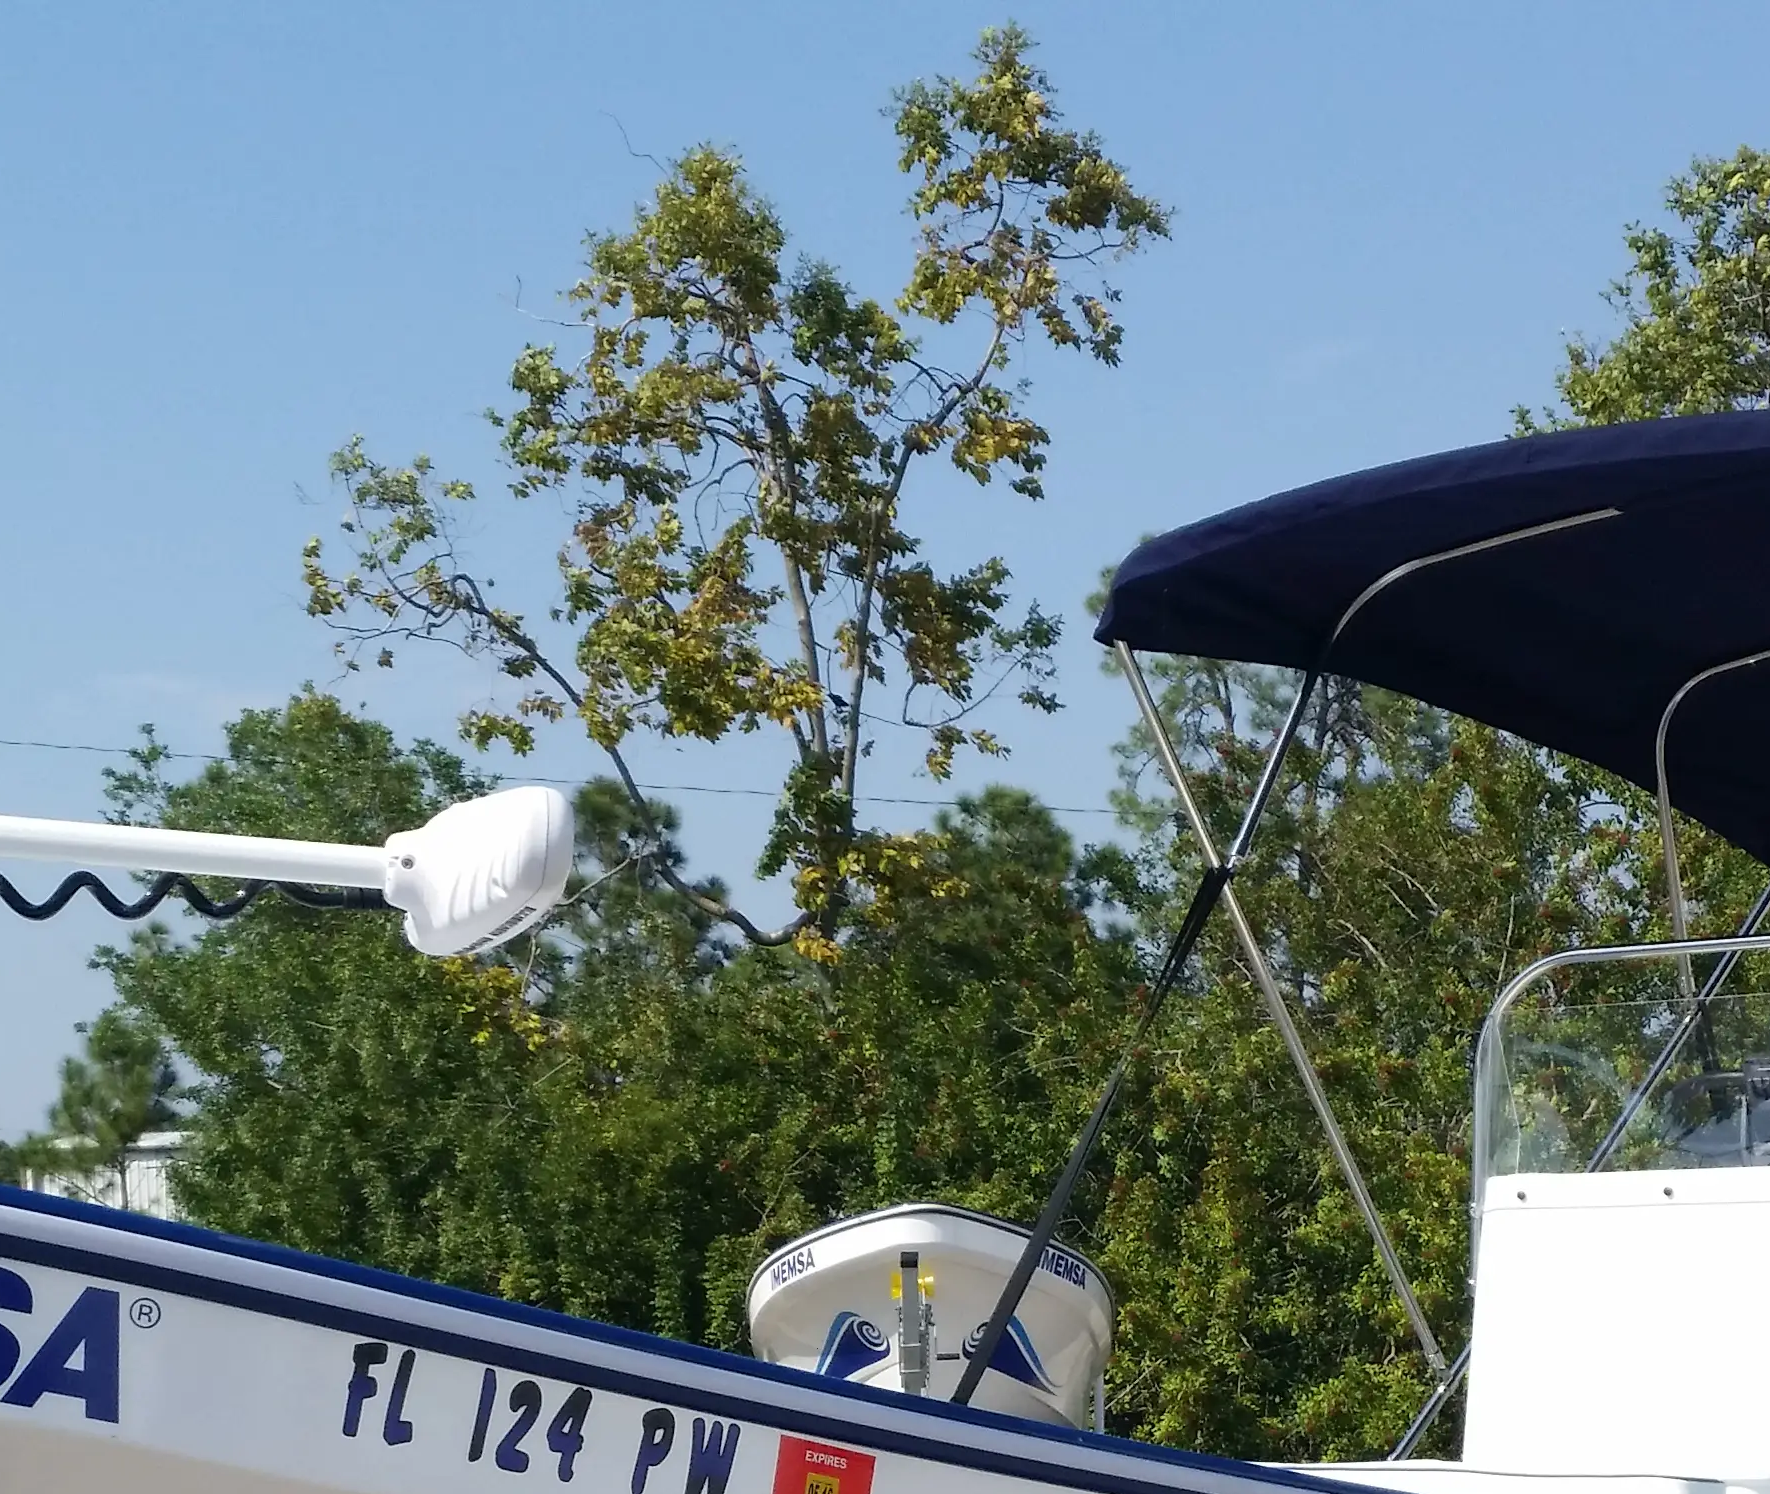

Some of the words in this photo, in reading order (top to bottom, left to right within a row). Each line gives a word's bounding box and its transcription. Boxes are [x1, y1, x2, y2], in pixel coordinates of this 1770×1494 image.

[770, 1247, 816, 1291] IMEMSA
[1040, 1249, 1085, 1290] MEMSA
[342, 1342, 417, 1446] FL
[468, 1367, 592, 1482] 124
[805, 1450, 847, 1469] EXPIRES
